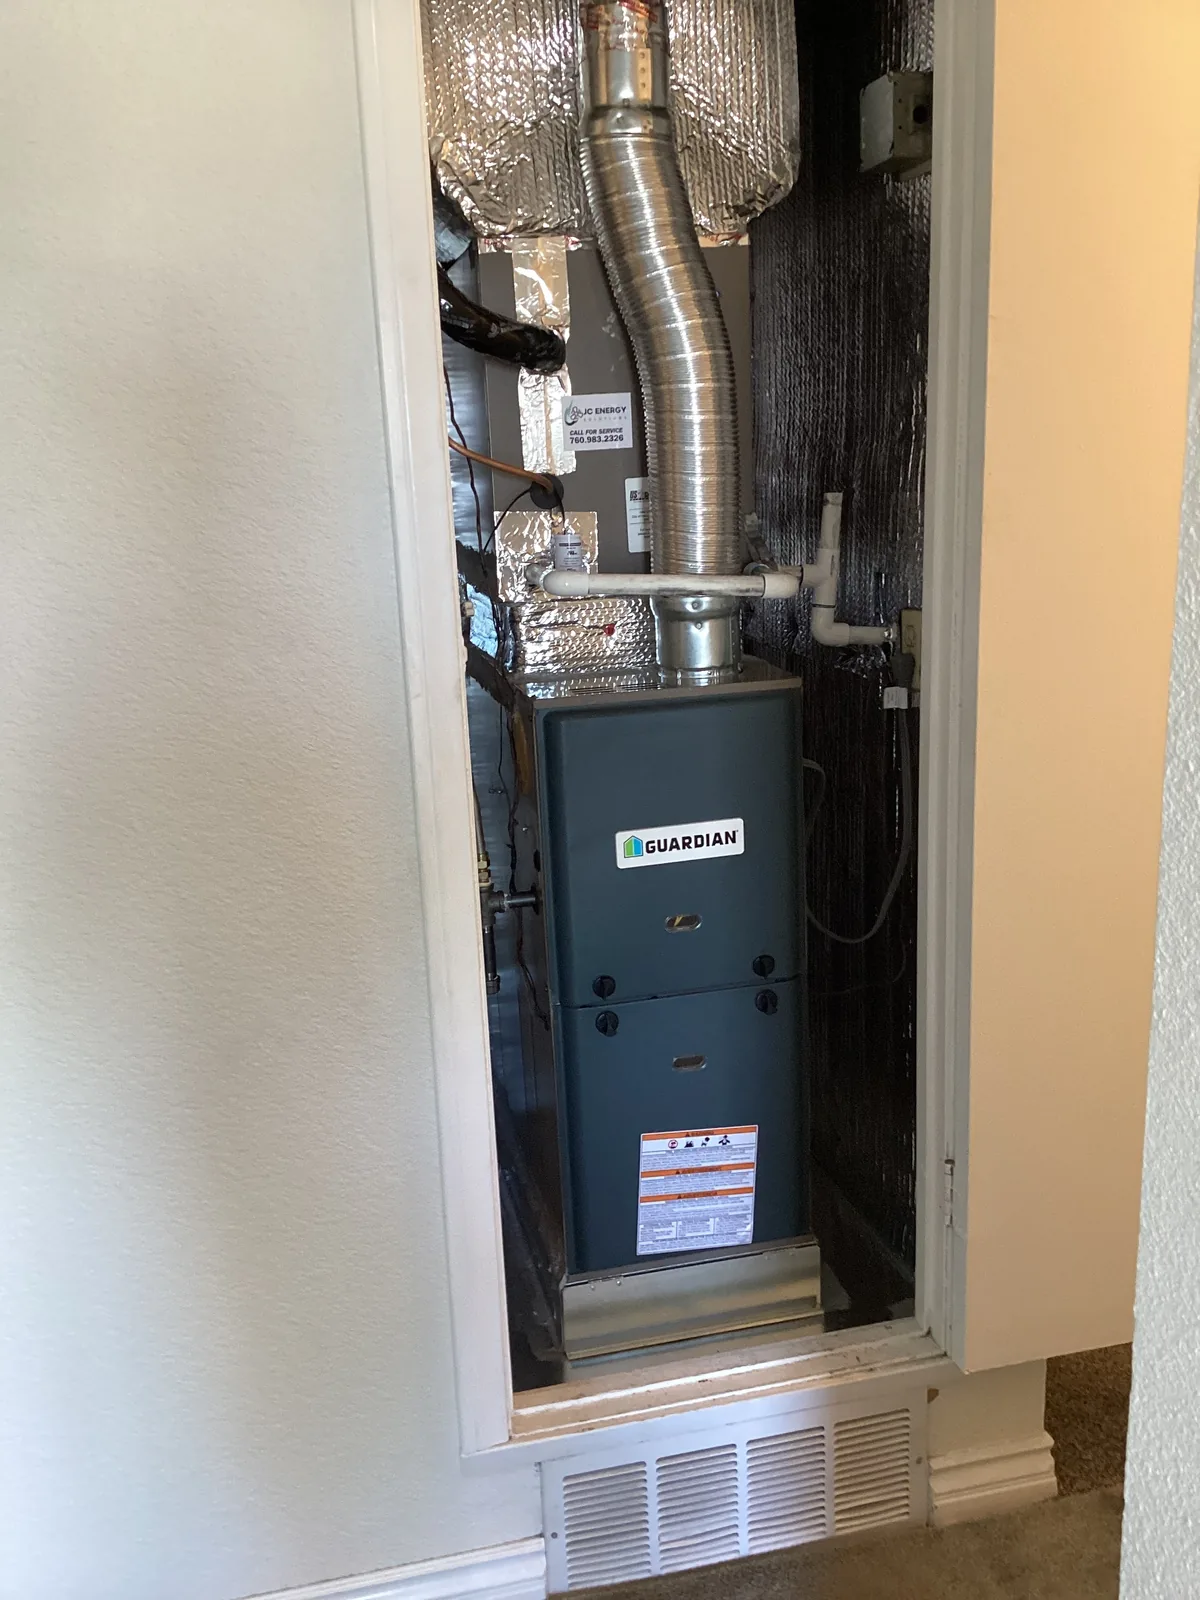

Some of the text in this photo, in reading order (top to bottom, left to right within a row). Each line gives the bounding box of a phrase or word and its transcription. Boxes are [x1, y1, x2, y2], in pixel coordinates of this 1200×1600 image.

[583, 406, 627, 415] JC ENERGY
[599, 427, 623, 435] SERVICE
[569, 434, 624, 444] 760.983.2326
[645, 830, 737, 854] GUARDIAN
